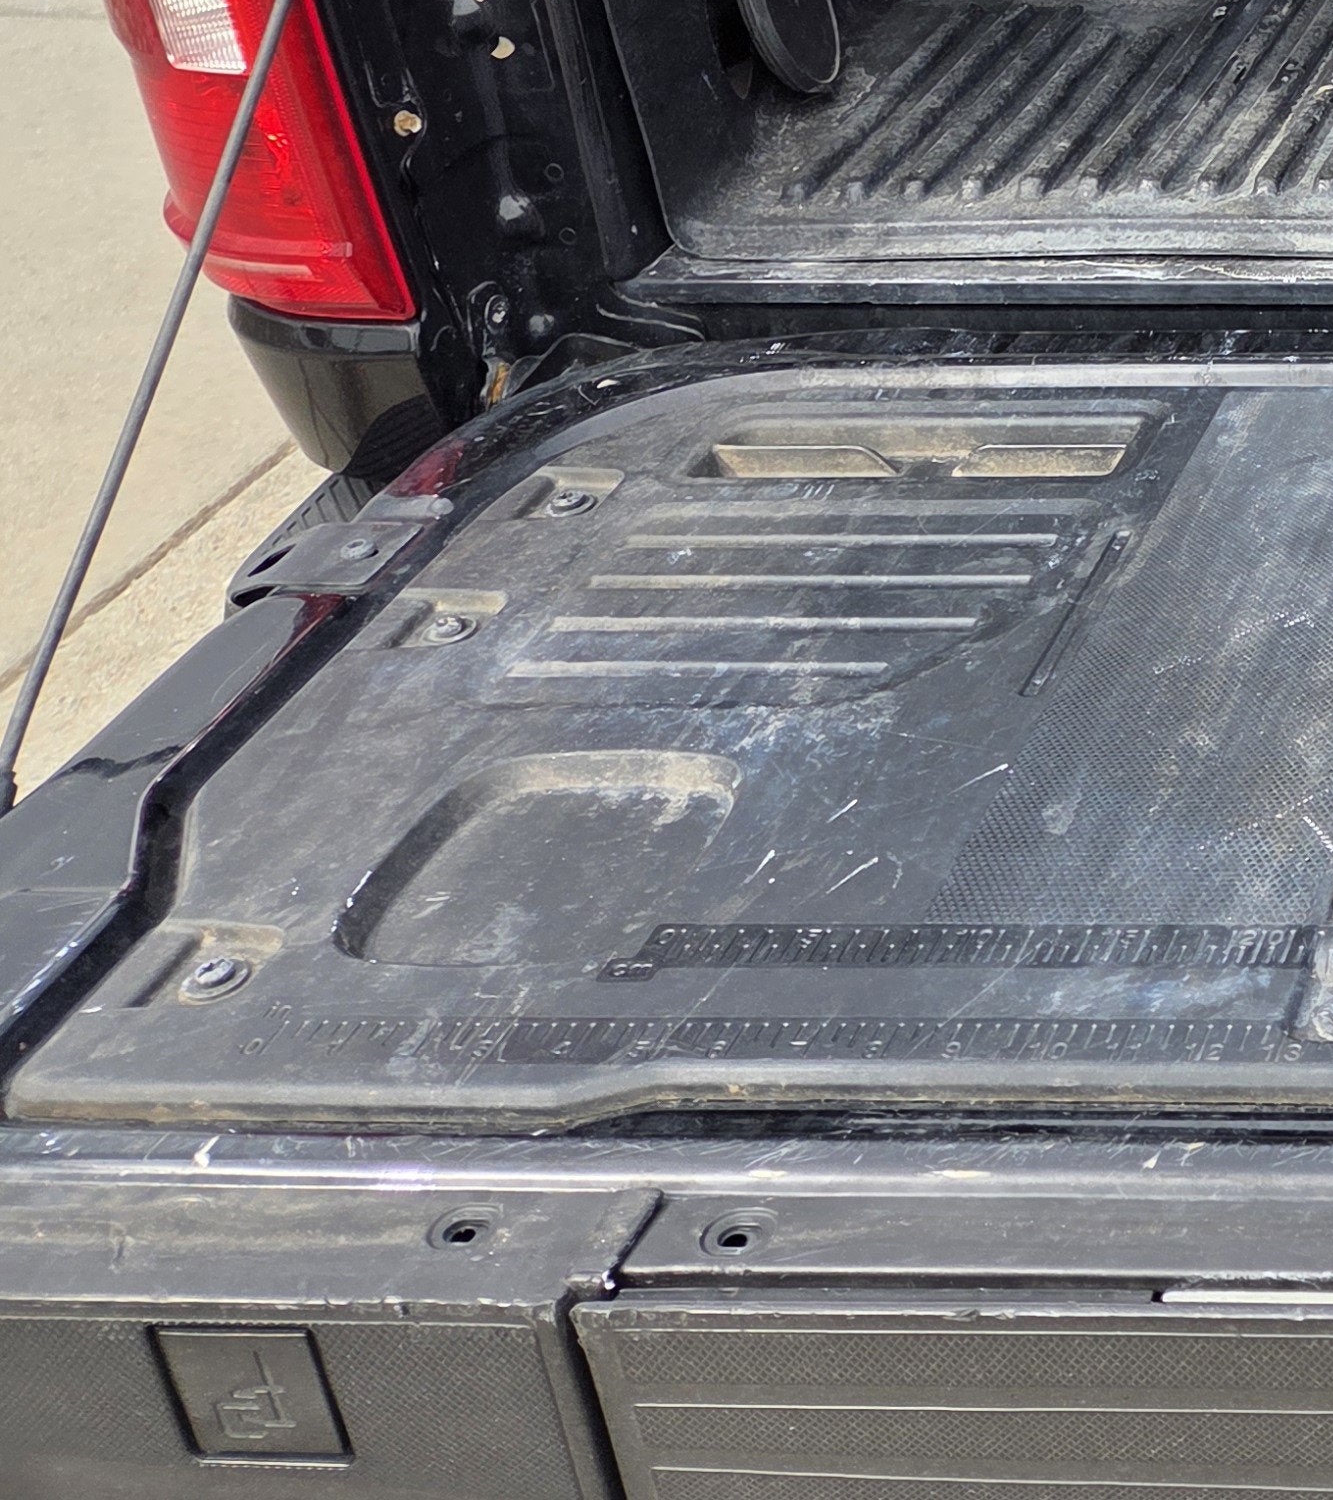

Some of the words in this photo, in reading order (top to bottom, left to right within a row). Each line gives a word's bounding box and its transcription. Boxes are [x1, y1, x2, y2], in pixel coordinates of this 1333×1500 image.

[1239, 929, 1284, 946] 20
[612, 963, 653, 977] cm
[1186, 1043, 1224, 1062] 12
[1261, 1043, 1302, 1062] 13
